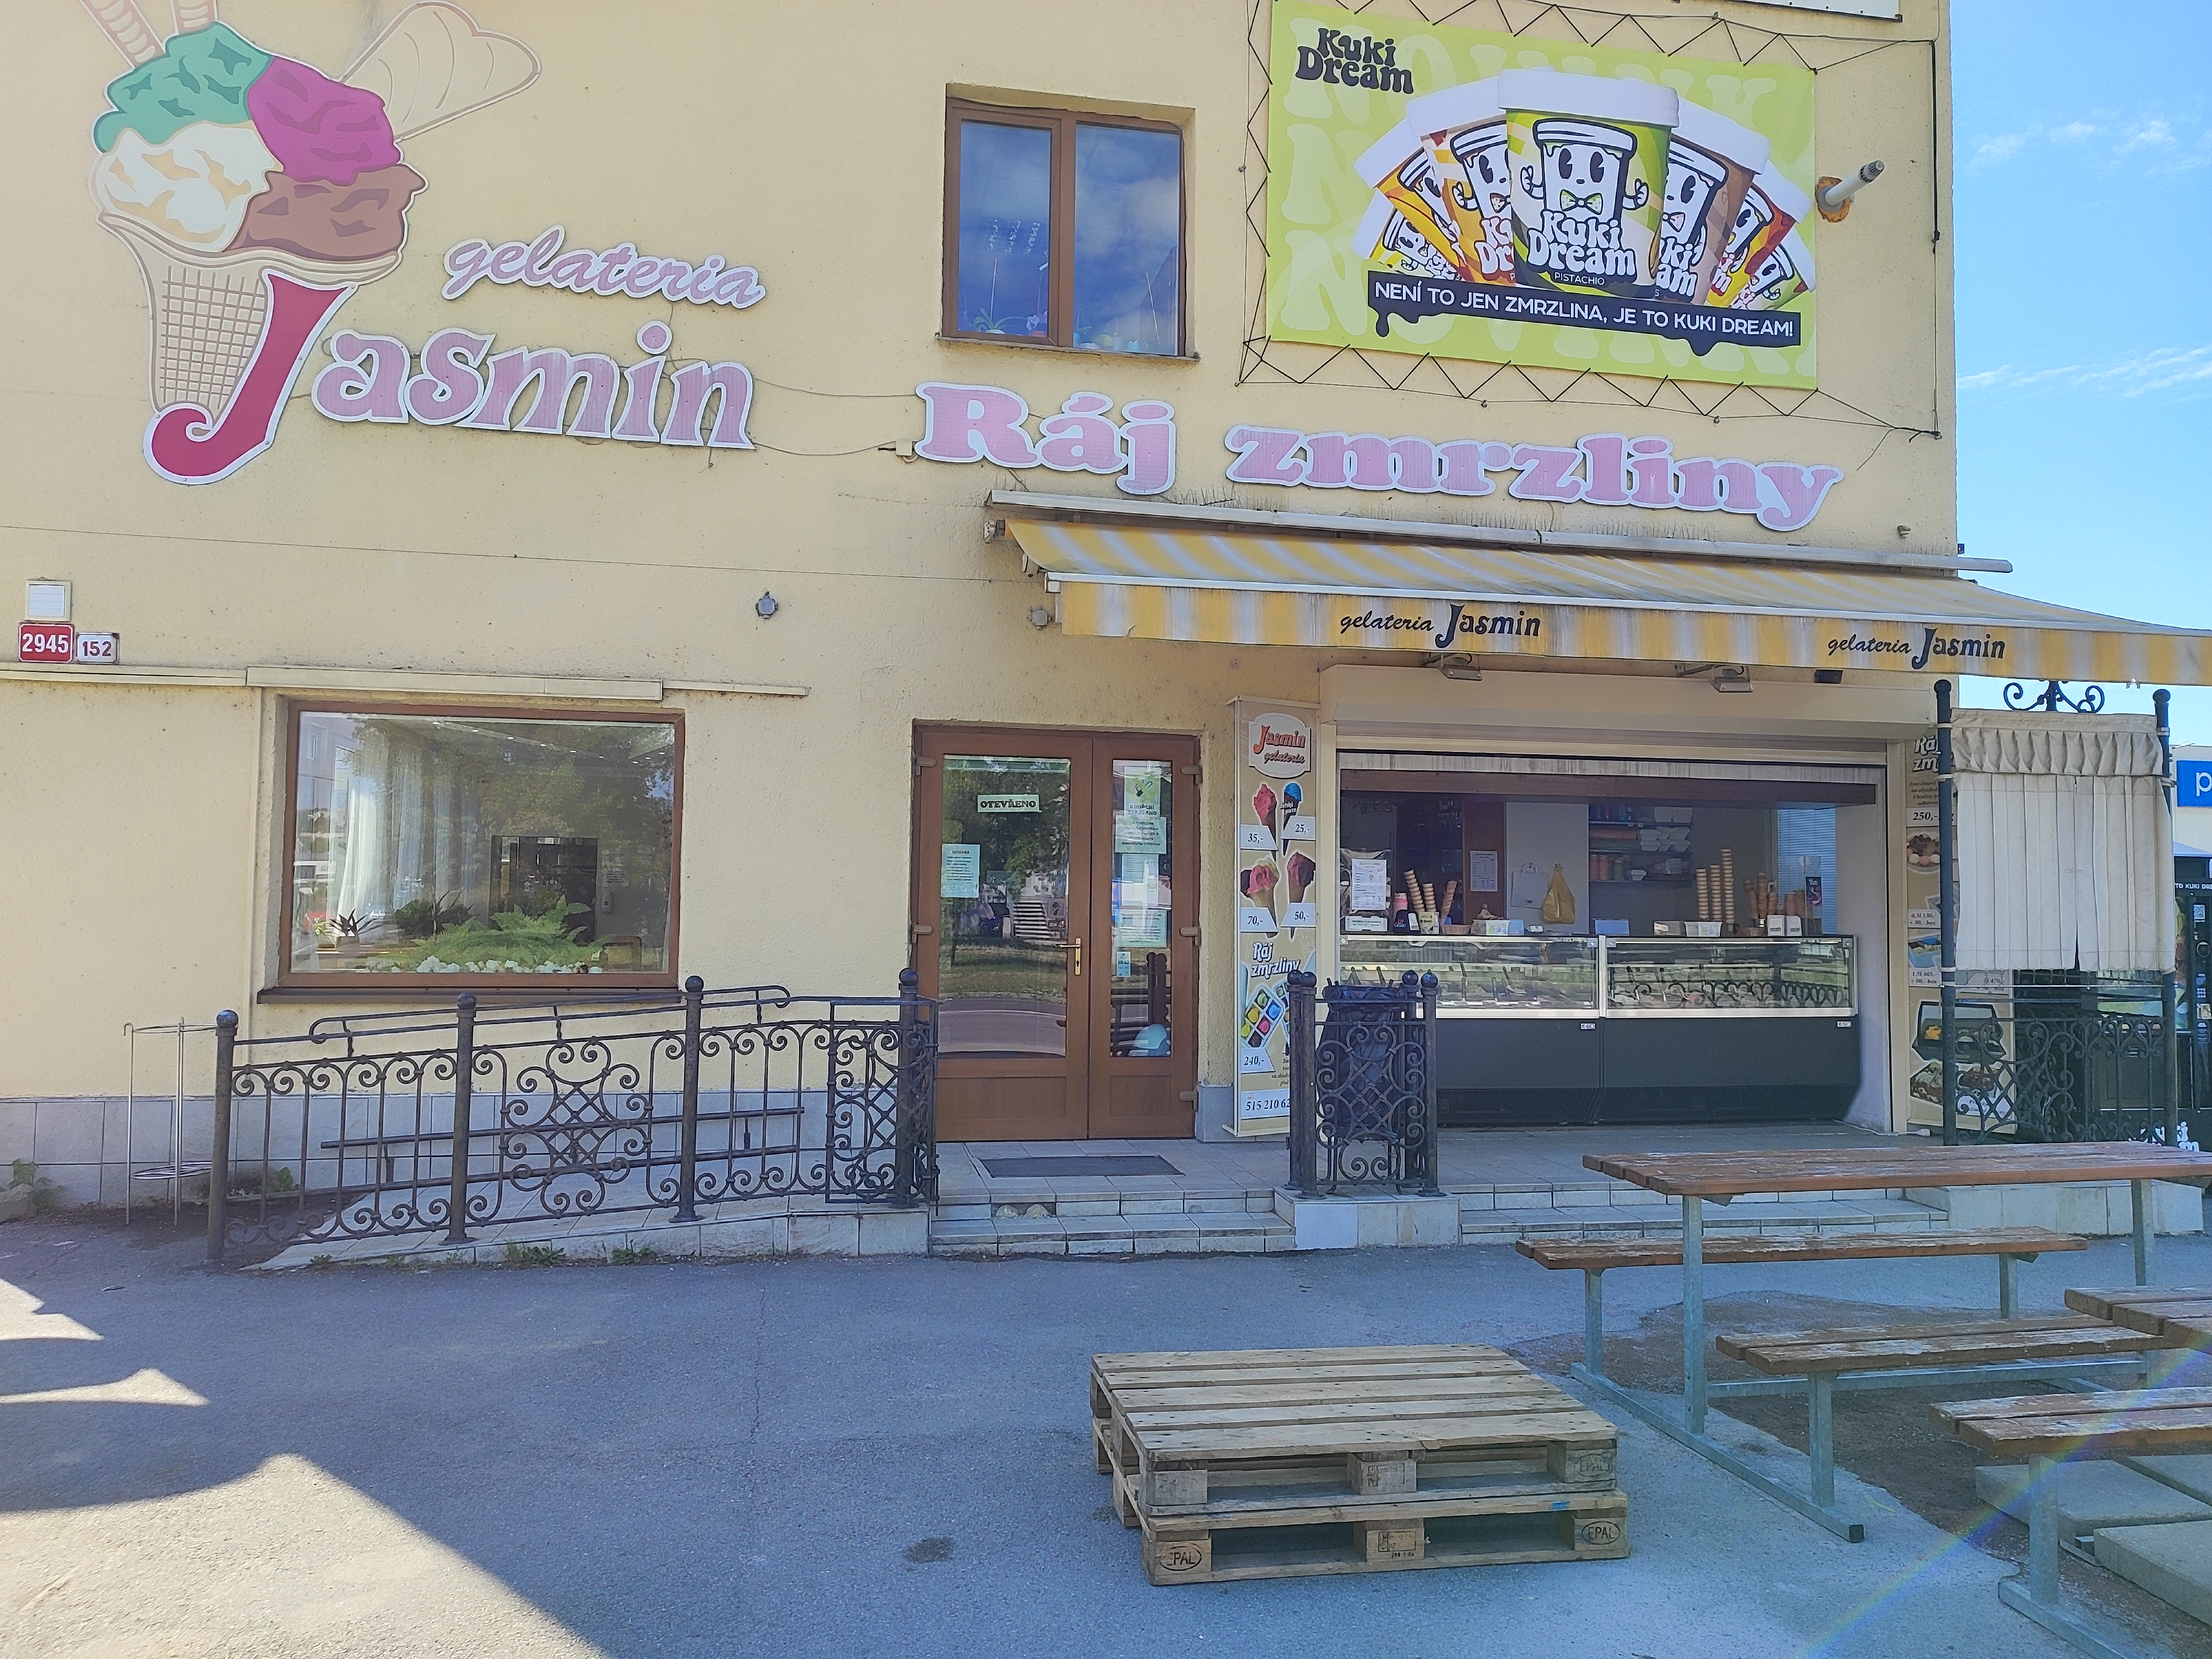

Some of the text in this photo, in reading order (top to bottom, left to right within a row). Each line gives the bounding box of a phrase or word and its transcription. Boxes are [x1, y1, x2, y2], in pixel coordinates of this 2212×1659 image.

[1317, 28, 1396, 67] Kuki
[1295, 46, 1414, 95] Dream
[1542, 211, 1620, 249] Kuki
[1528, 229, 1636, 275] Dream
[444, 227, 765, 307] gelateria
[1554, 272, 1605, 285] PISTACHIO
[1375, 280, 1793, 337] NENÍ TO JEN ZMRZLINA, JE TO KUKI DREAM!
[144, 268, 756, 485] Jasmin
[916, 382, 1844, 531] Ráj zmrzliny
[1340, 603, 1541, 648] gelateria Jasmin
[22, 633, 69, 653] 2945
[82, 640, 112, 656] 152
[1828, 627, 2005, 669] gelateria Jasmin
[1253, 724, 1306, 754] Jasmin
[980, 798, 1036, 808] OTEVŘENO
[1248, 833, 1264, 844] 35,-
[1295, 824, 1310, 834] 25,-
[1248, 915, 1264, 926] 70,-
[1295, 911, 1310, 921] 50,-
[1253, 942, 1274, 963] Ráj
[1251, 957, 1301, 979] zmrzliny
[1244, 1055, 1265, 1066] 240,-
[1245, 1098, 1290, 1111] 515 210 62
[1588, 1526, 1615, 1540] EPAL
